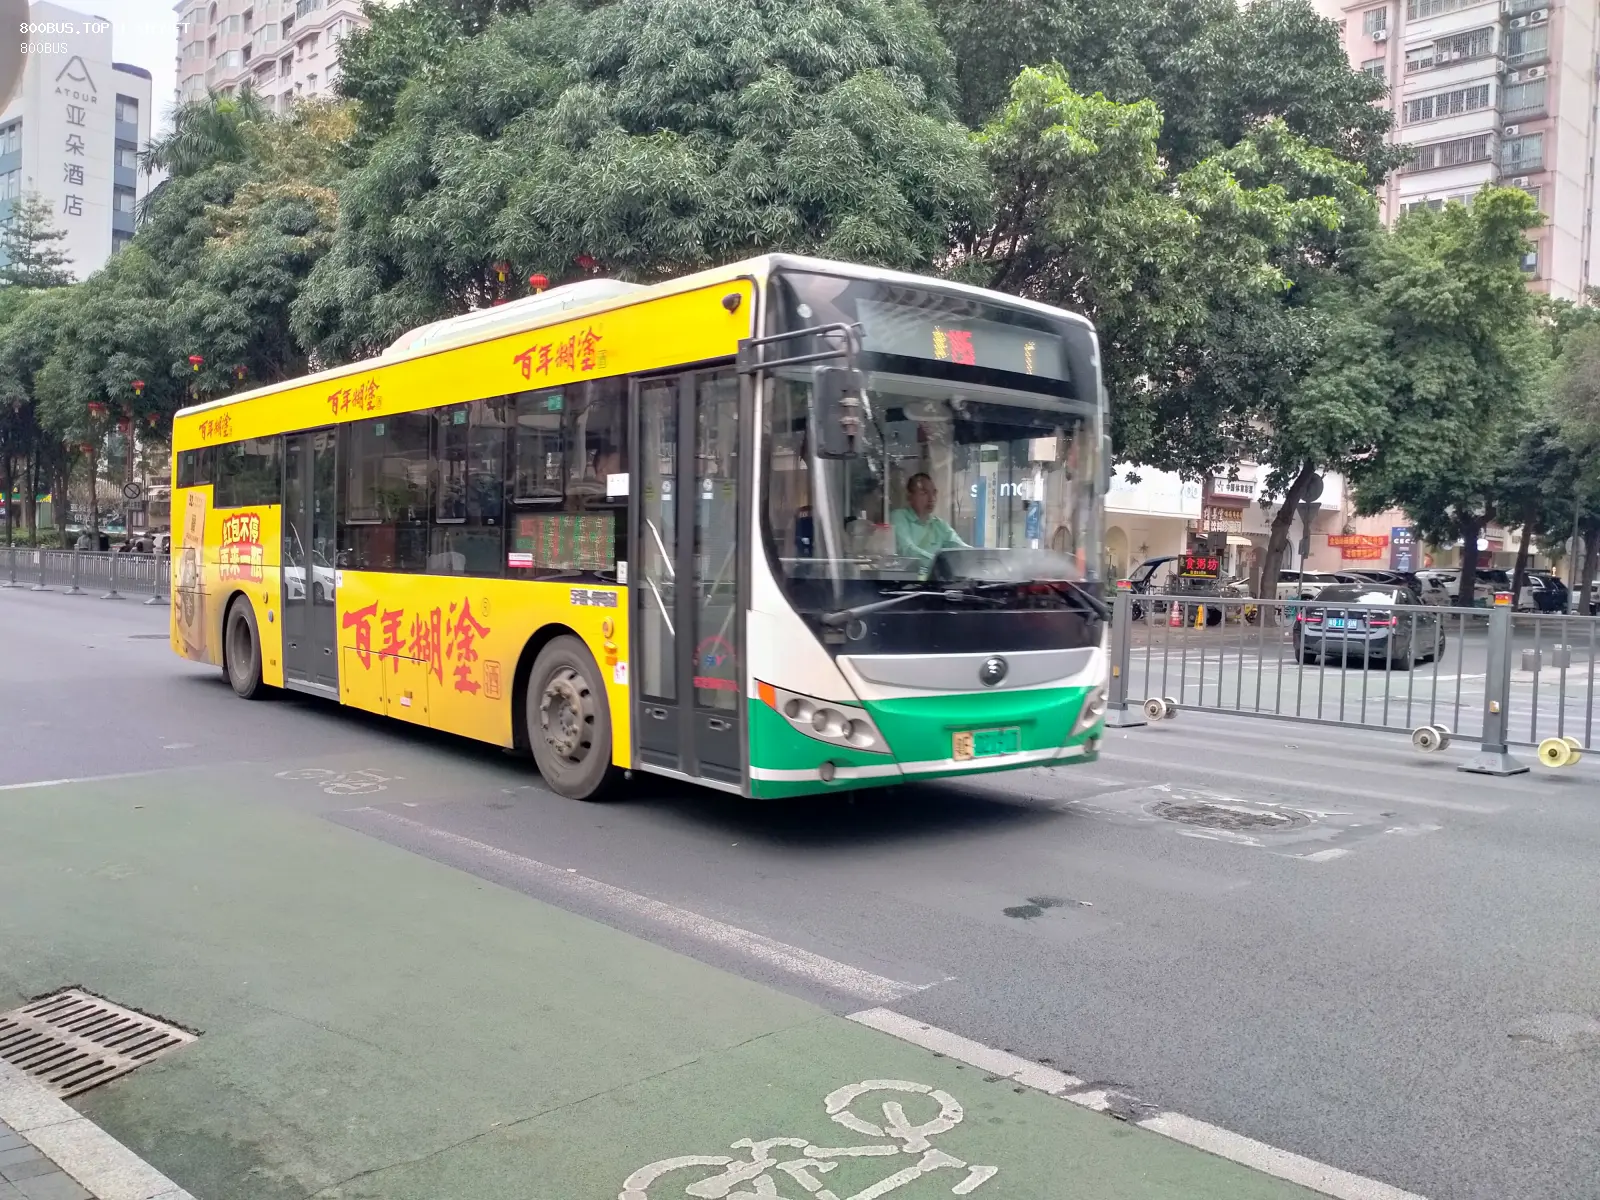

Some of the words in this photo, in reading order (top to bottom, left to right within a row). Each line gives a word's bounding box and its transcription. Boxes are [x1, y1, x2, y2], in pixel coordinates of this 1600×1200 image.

[54, 86, 97, 105] ATOUR
[63, 103, 86, 218] 亚朵酒店
[222, 515, 261, 547] 红包不停
